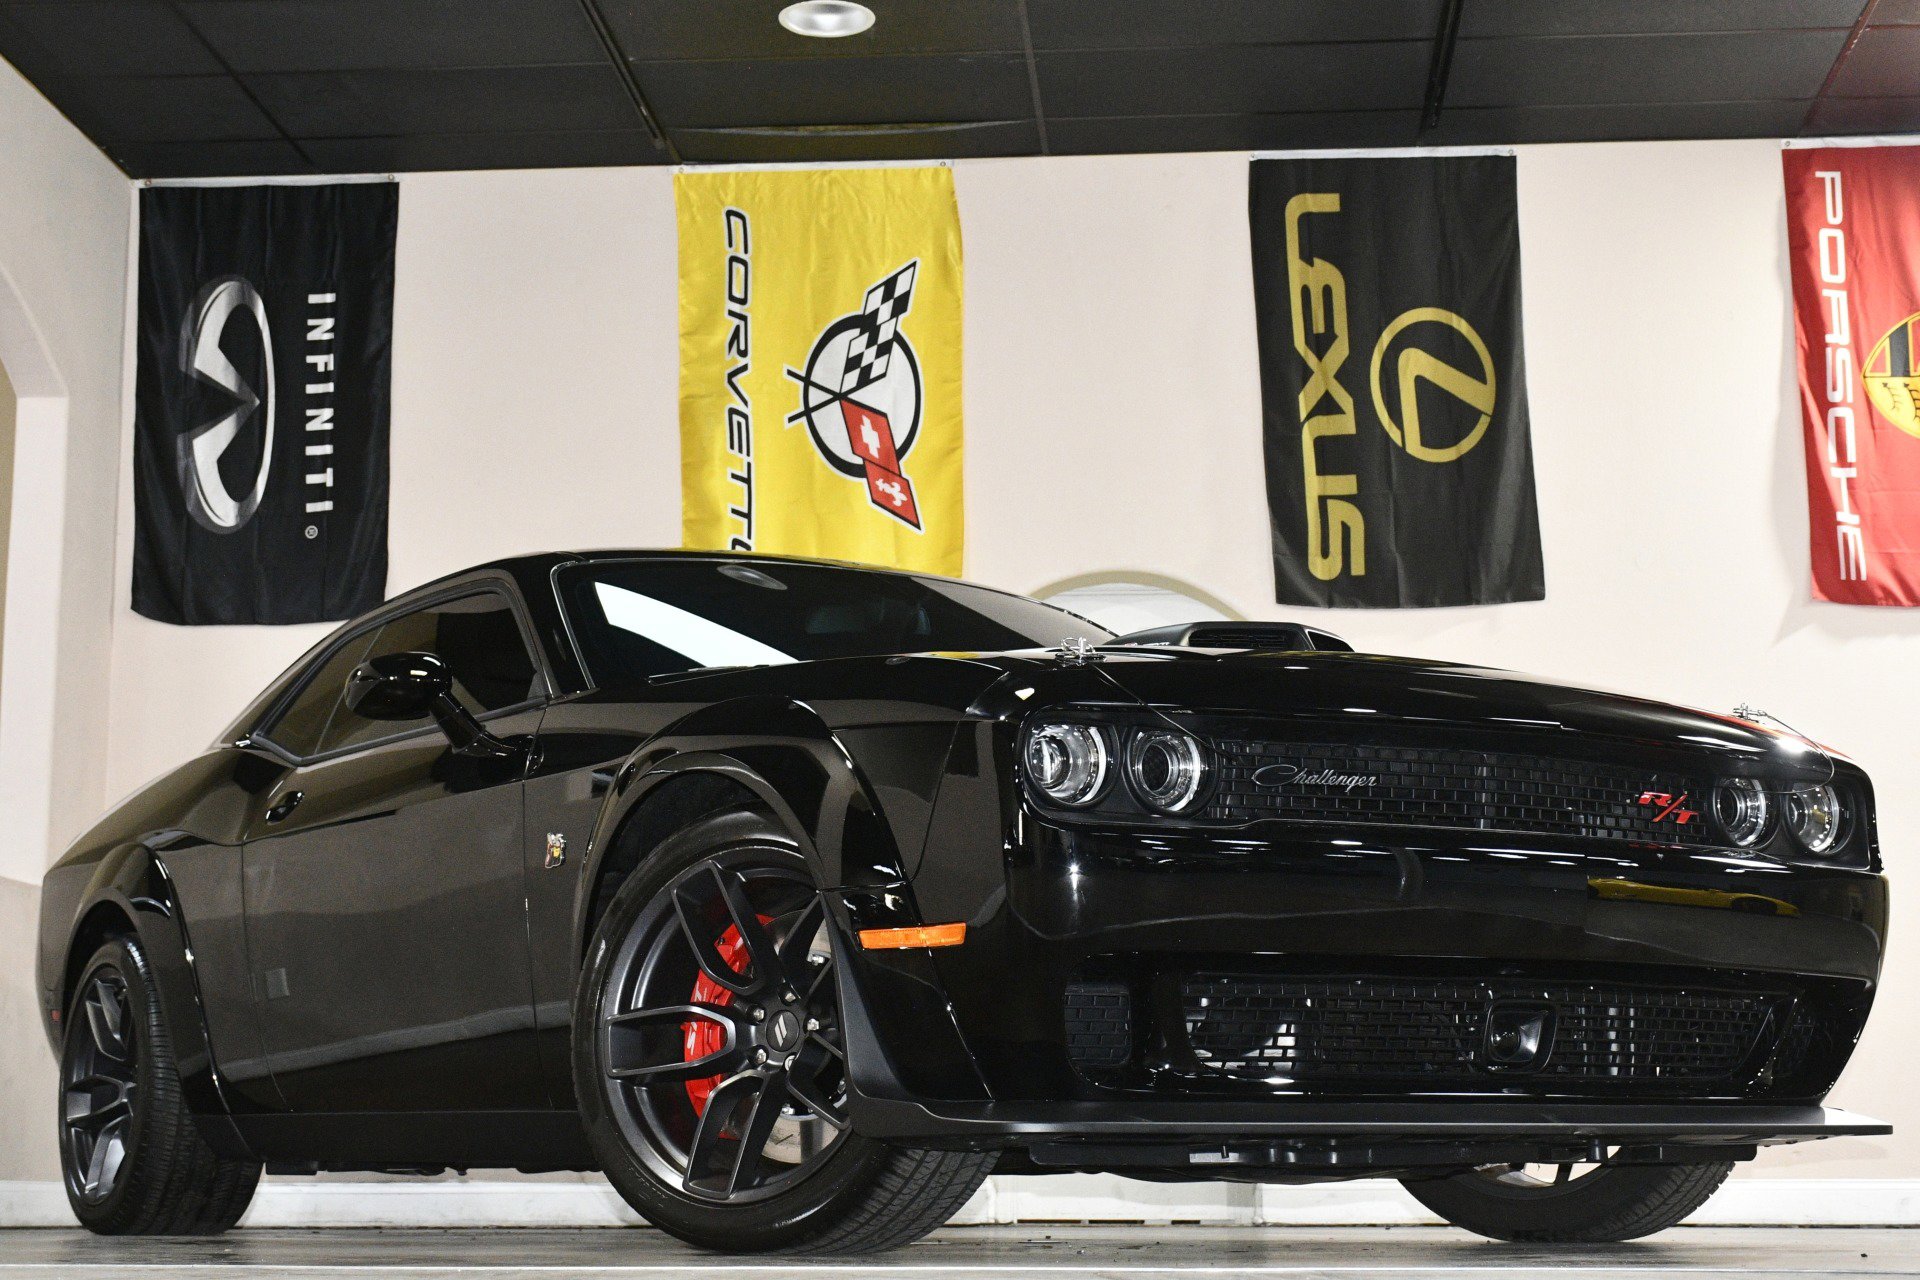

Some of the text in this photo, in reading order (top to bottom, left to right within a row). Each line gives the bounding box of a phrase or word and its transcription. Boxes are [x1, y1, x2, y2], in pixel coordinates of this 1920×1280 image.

[305, 292, 336, 513] INFINITI
[1285, 193, 1365, 581] LEXUS
[1815, 171, 1867, 581] PORSCHE
[1251, 764, 1378, 793] Challenger
[1639, 791, 1699, 825] R/T
